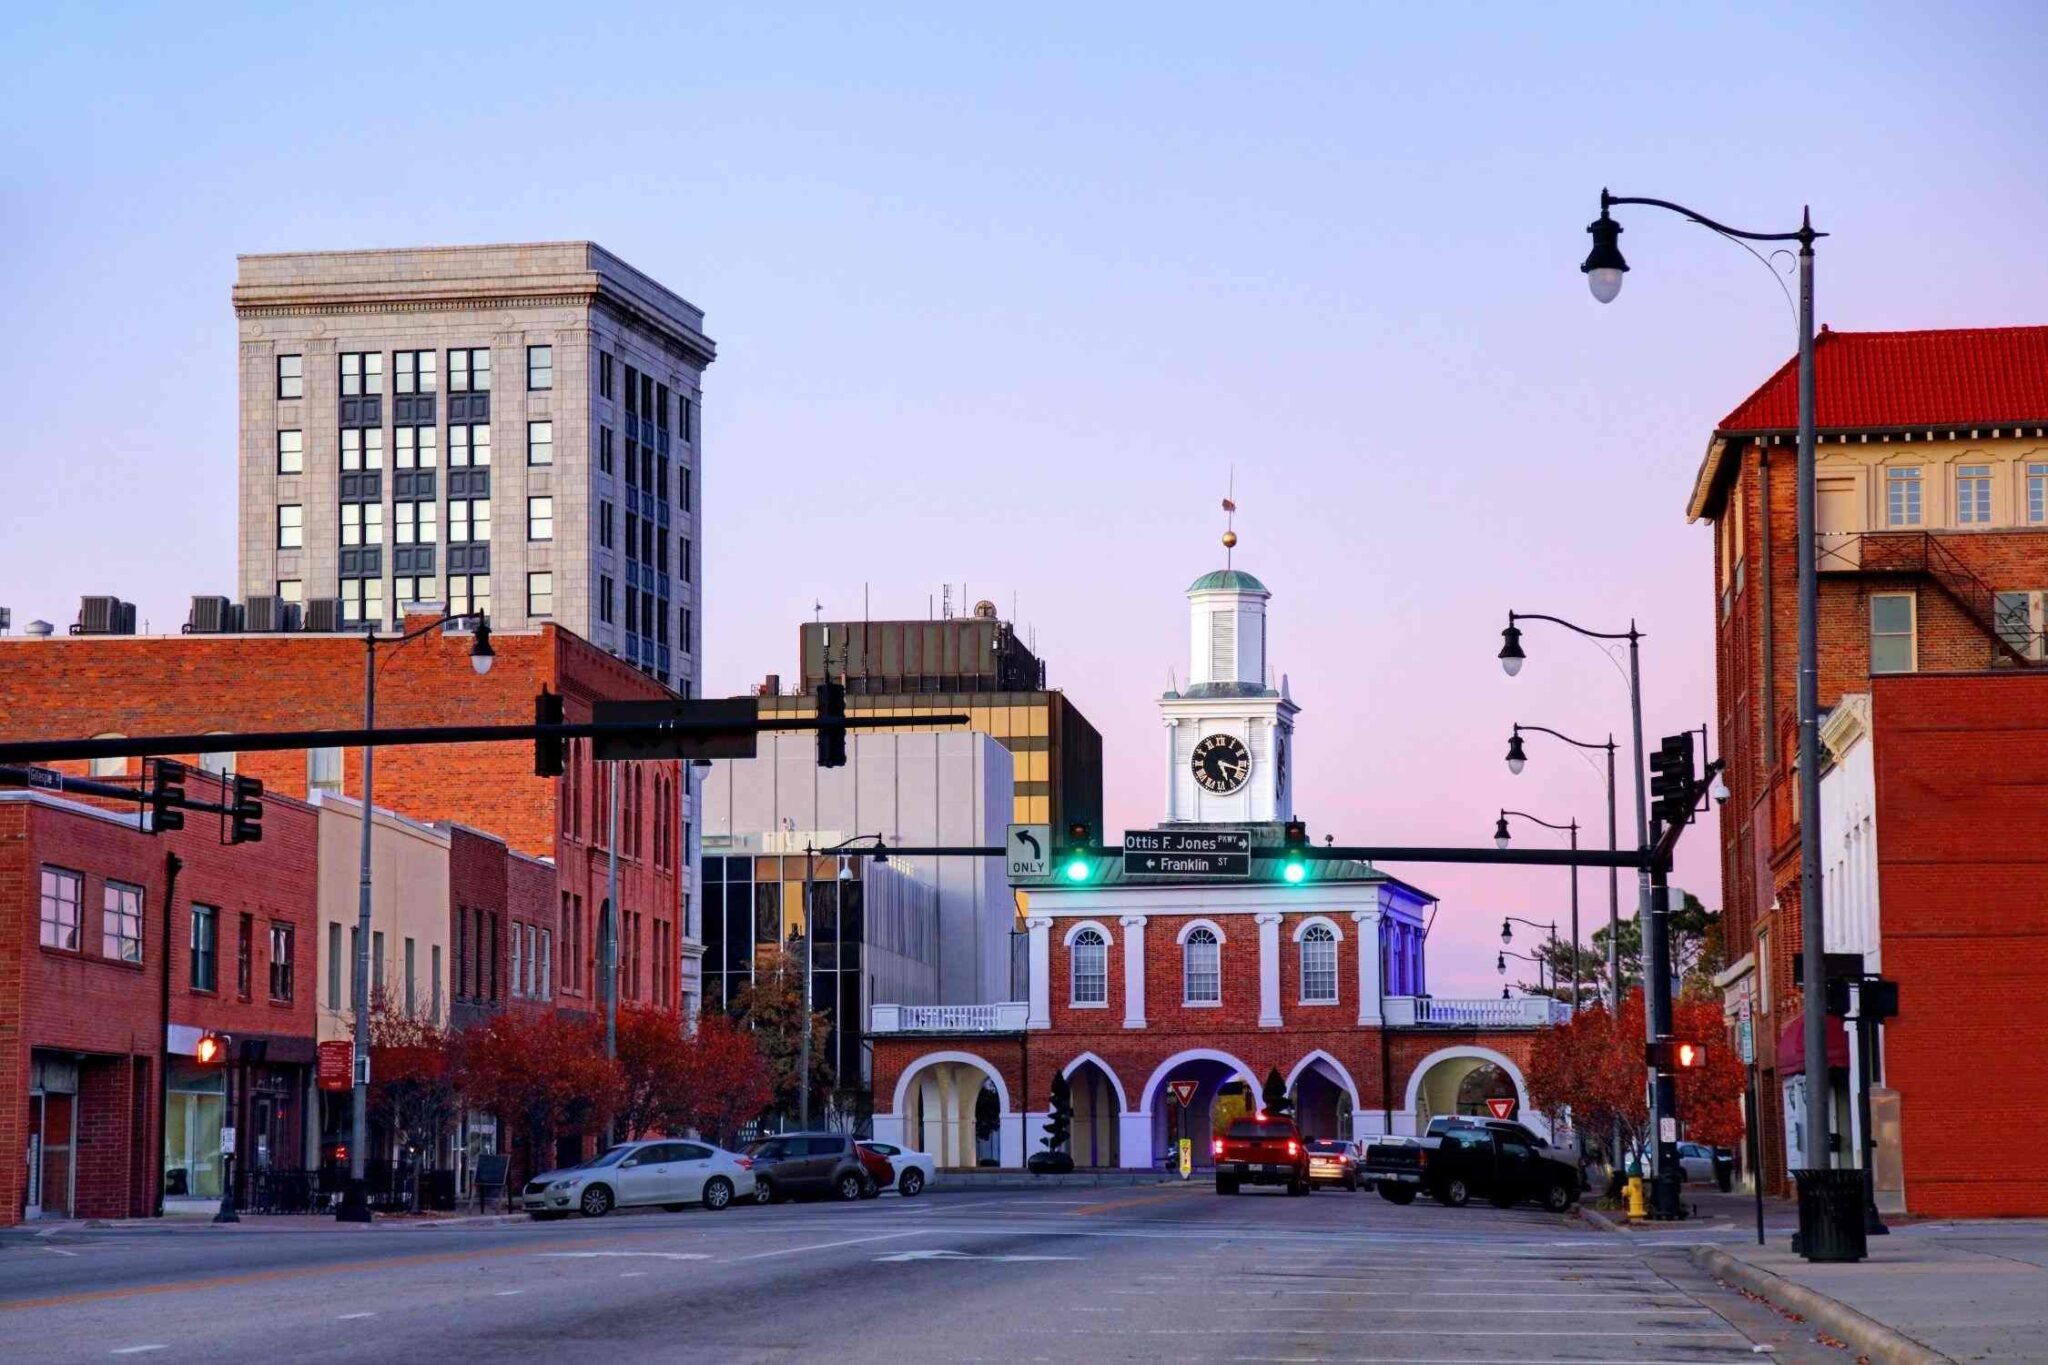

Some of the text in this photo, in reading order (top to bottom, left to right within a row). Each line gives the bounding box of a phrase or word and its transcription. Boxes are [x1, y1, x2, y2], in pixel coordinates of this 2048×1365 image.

[1126, 834, 1238, 850] Ottis F. Jones PKWY
[1013, 862, 1045, 873] ONLY
[1160, 857, 1229, 871] Franklin ST
